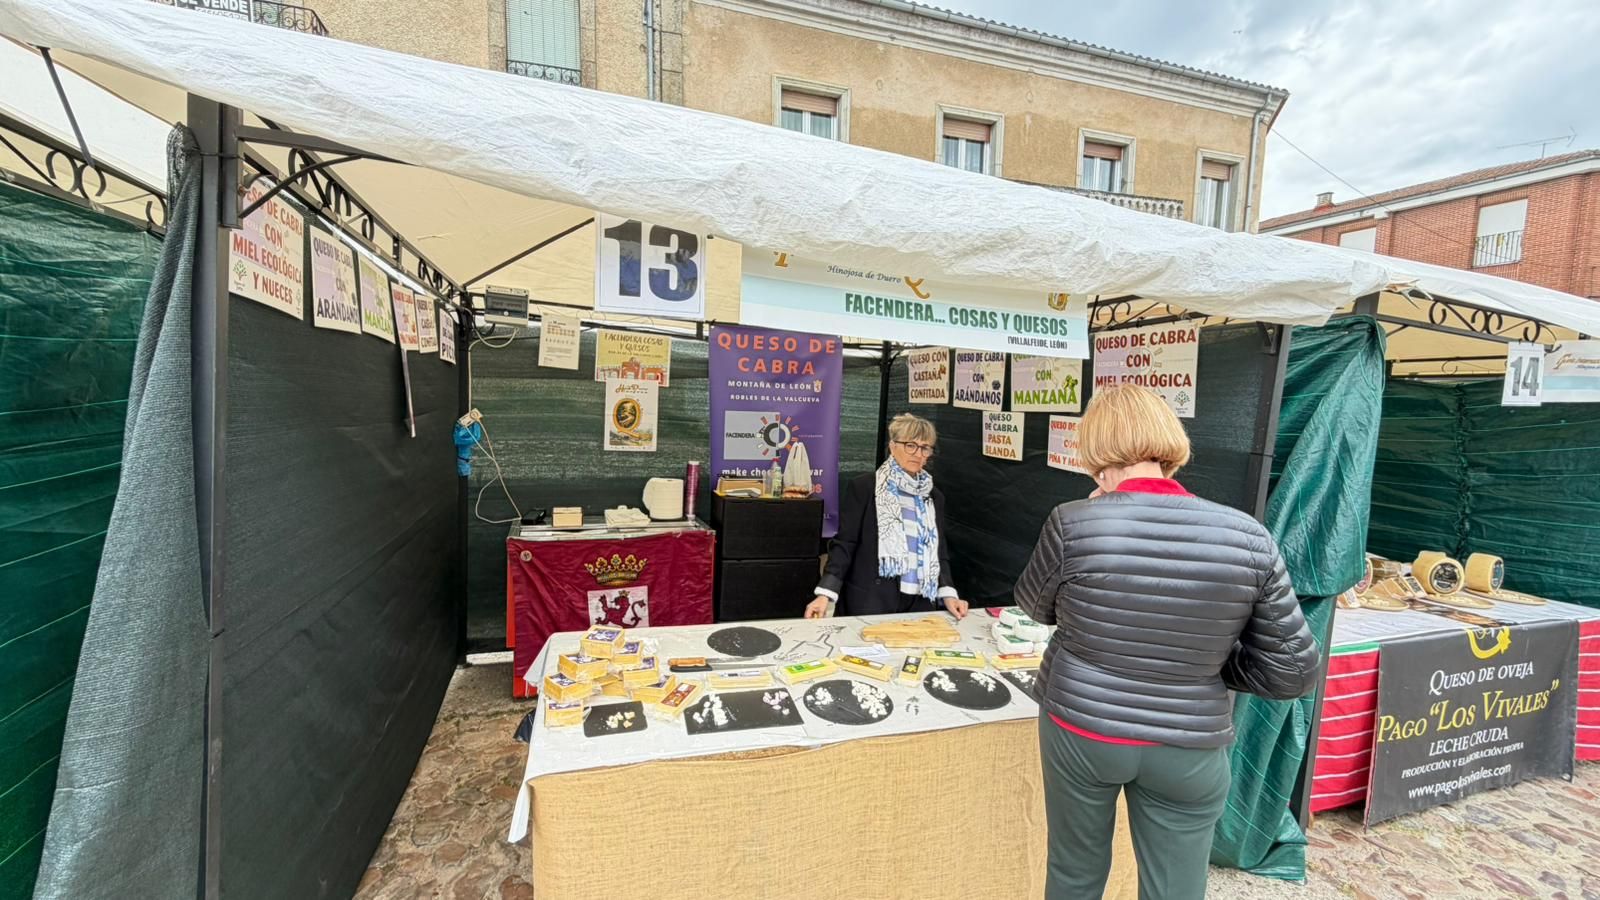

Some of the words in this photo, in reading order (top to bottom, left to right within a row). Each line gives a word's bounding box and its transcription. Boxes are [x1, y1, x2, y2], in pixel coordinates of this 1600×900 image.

[267, 199, 279, 220] DE
[264, 223, 283, 248] CON
[233, 233, 259, 262] MIEL
[261, 248, 302, 284] ECOLÓGICA
[604, 218, 699, 302] 13
[827, 265, 864, 279] Hinojosa
[865, 270, 875, 280] de
[877, 272, 902, 284] Duero
[253, 271, 259, 290] Y
[262, 275, 293, 305] NUECES
[845, 292, 946, 324] FACENDERA...
[949, 306, 998, 330] COSAS
[1001, 313, 1010, 330] Y
[1013, 313, 1068, 337] QUESOS
[717, 332, 798, 352] QUESO
[809, 338, 836, 353] DE
[1096, 335, 1128, 354] QUESO
[1130, 333, 1146, 347] DE
[1149, 329, 1197, 346] CABRA
[737, 356, 815, 376] CABRA
[910, 352, 930, 367] QUESO
[931, 351, 948, 363] CON
[957, 353, 975, 365] QUESO
[976, 353, 984, 362] DE
[984, 353, 1005, 362] CABRA
[1126, 353, 1151, 368] CON
[913, 368, 942, 382] CASTAÑA
[972, 373, 985, 383] CON
[1035, 369, 1052, 381] CON
[1510, 356, 1540, 396] 14
[727, 380, 771, 389] MONTAÑA
[774, 382, 786, 390] DE
[789, 382, 811, 390] LEÓN
[910, 388, 946, 399] CONFITADA
[955, 386, 1001, 405] ARÁNDANOS
[1013, 388, 1078, 405] MANZANA
[988, 412, 1012, 423] QUESO
[1051, 420, 1067, 431] QUESO
[725, 431, 755, 439] FACENDERA
[985, 422, 992, 430] DE
[993, 423, 1018, 433] CABRA
[988, 434, 1012, 445] PASTA
[985, 445, 1017, 459] BLANDA
[721, 467, 748, 477] make
[1429, 670, 1475, 695] QUESO
[1477, 666, 1495, 683] DE
[1497, 661, 1535, 681] OVEJA
[1376, 715, 1428, 743] PAGO
[1428, 736, 1469, 757] LECHE
[1469, 726, 1510, 747] CRUDA
[1401, 759, 1451, 779] PRODUCCIÓN
[1452, 758, 1458, 767] Y
